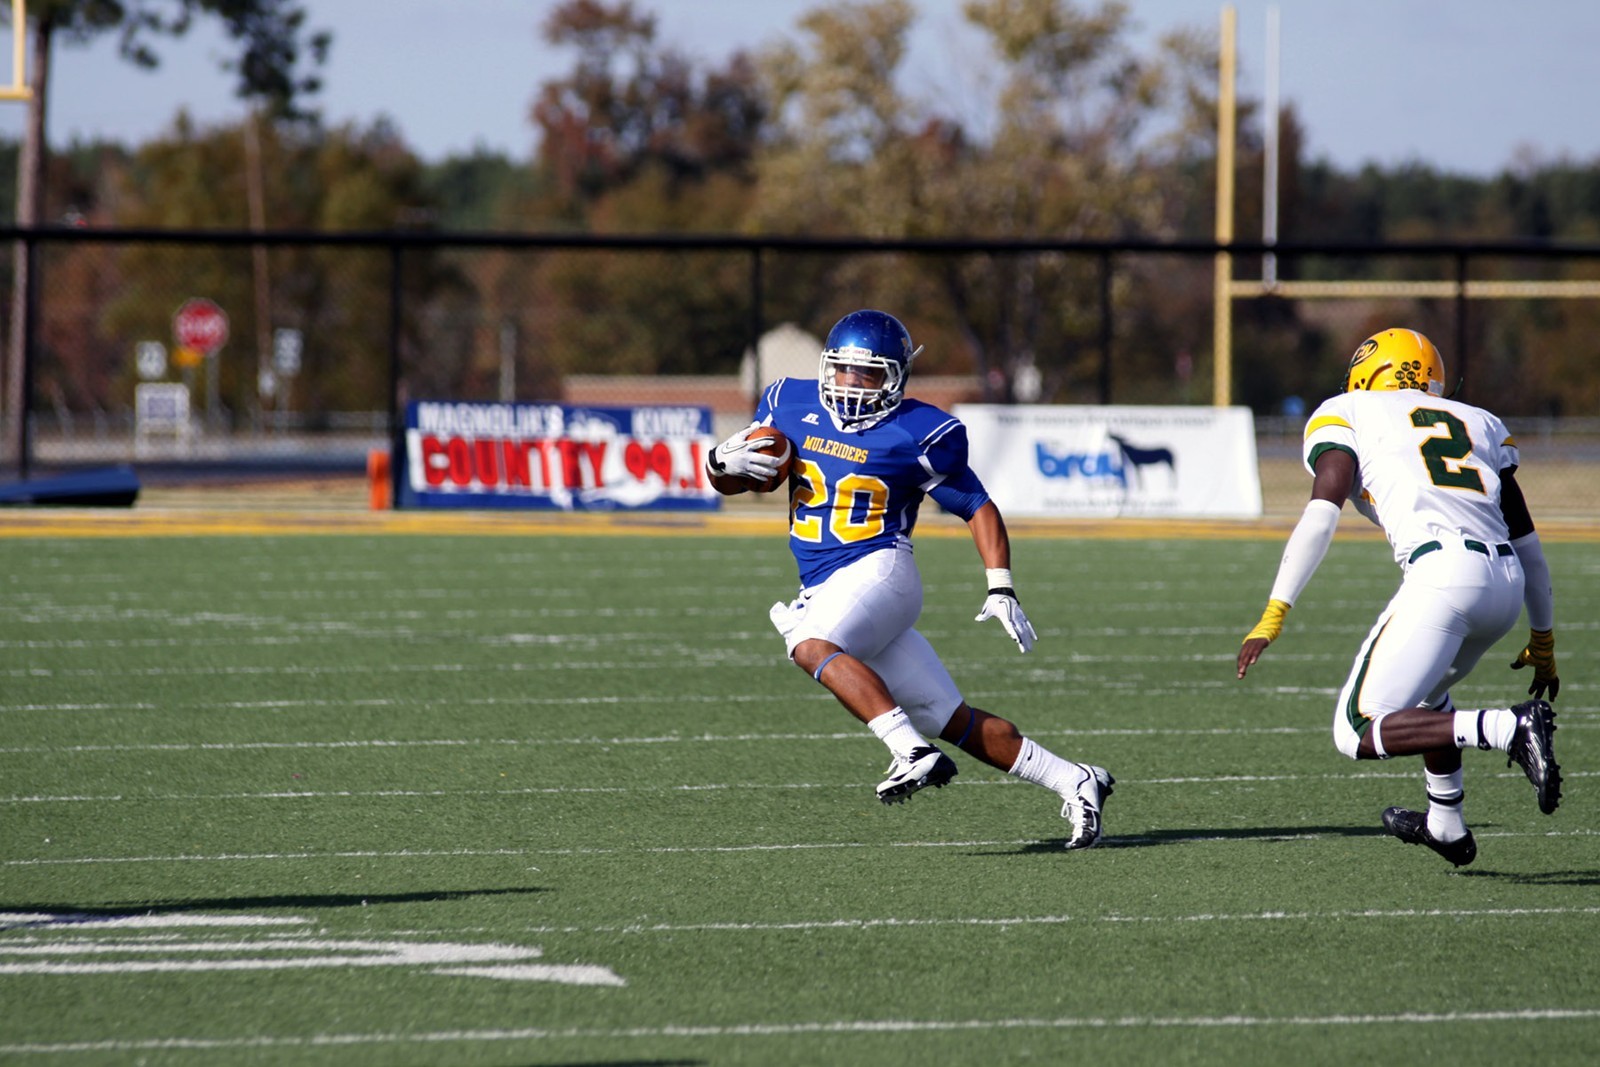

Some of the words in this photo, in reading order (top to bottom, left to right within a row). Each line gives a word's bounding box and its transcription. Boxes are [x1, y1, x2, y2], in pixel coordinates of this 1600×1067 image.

[421, 435, 606, 489] COUNTRY
[802, 435, 869, 464] MULERIDERS
[1408, 406, 1488, 496] 2
[790, 457, 890, 545] 20
